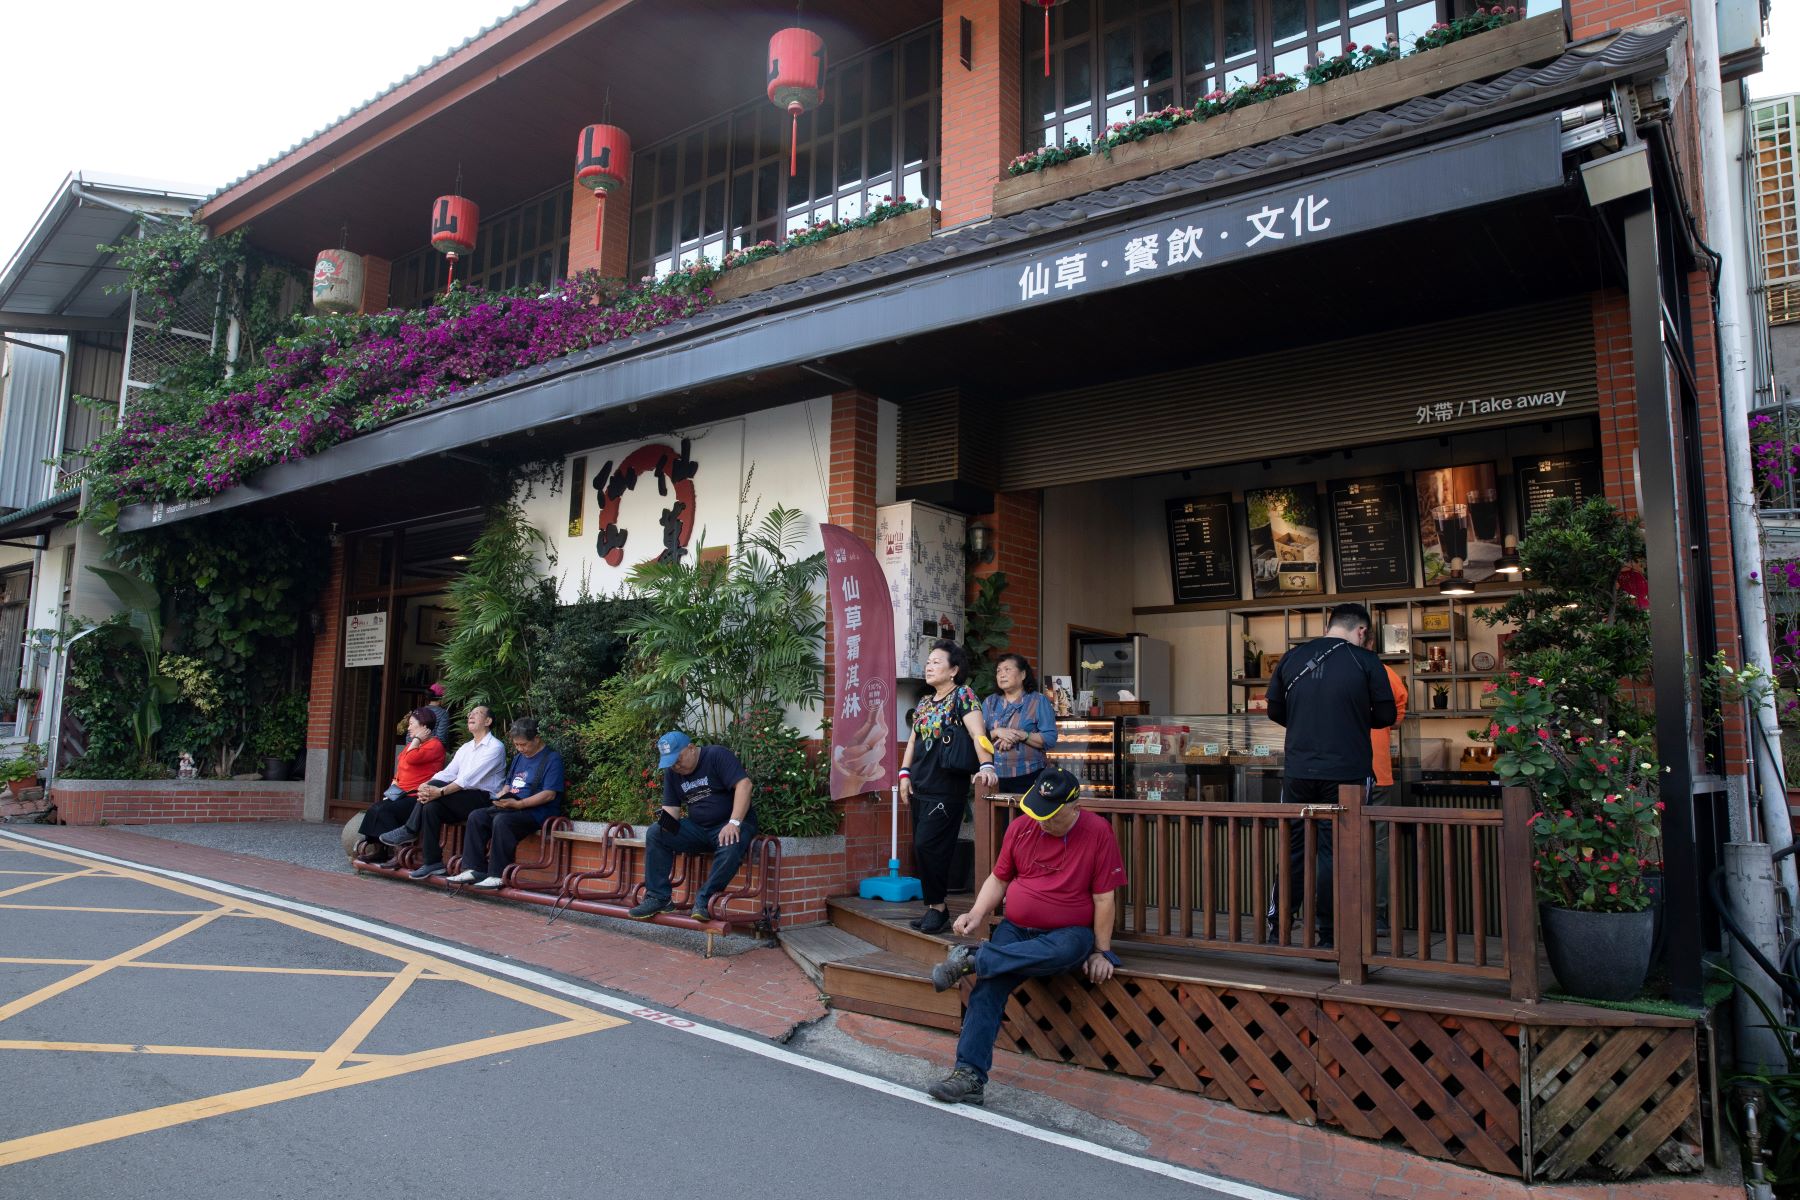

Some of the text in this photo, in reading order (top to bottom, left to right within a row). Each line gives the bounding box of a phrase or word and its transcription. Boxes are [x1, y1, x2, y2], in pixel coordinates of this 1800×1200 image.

[1415, 401, 1453, 424] 外帶
[1467, 396, 1513, 415] Take
[1516, 390, 1567, 407] away
[841, 575, 864, 719] 仙草霜淇淋
